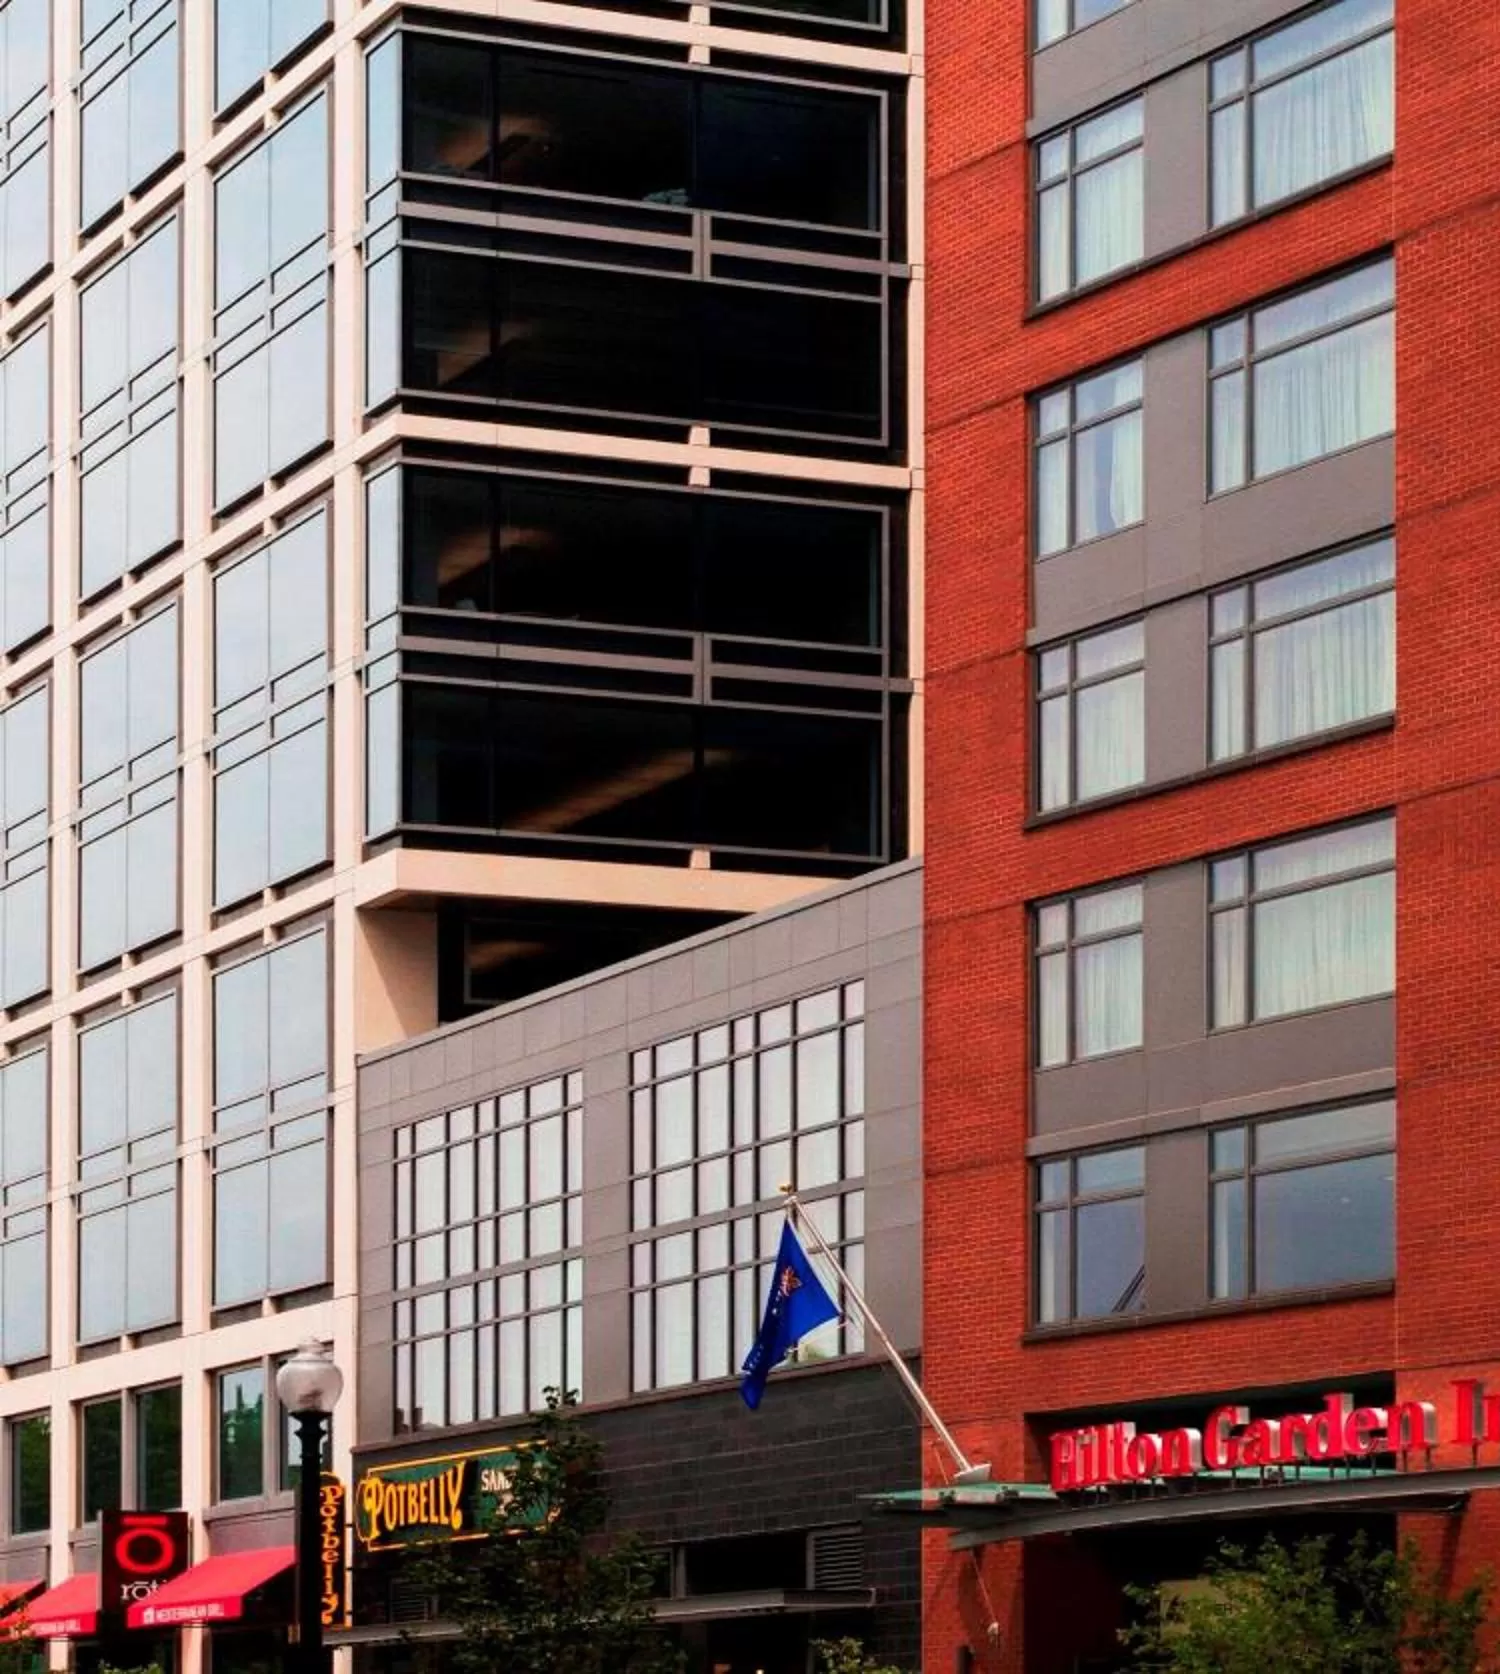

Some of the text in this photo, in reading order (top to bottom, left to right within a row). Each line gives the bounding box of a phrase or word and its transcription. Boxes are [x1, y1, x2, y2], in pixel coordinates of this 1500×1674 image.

[1050, 1421, 1199, 1492] Hilton
[1204, 1393, 1435, 1470] Garden
[362, 1460, 467, 1539] POTBELLY
